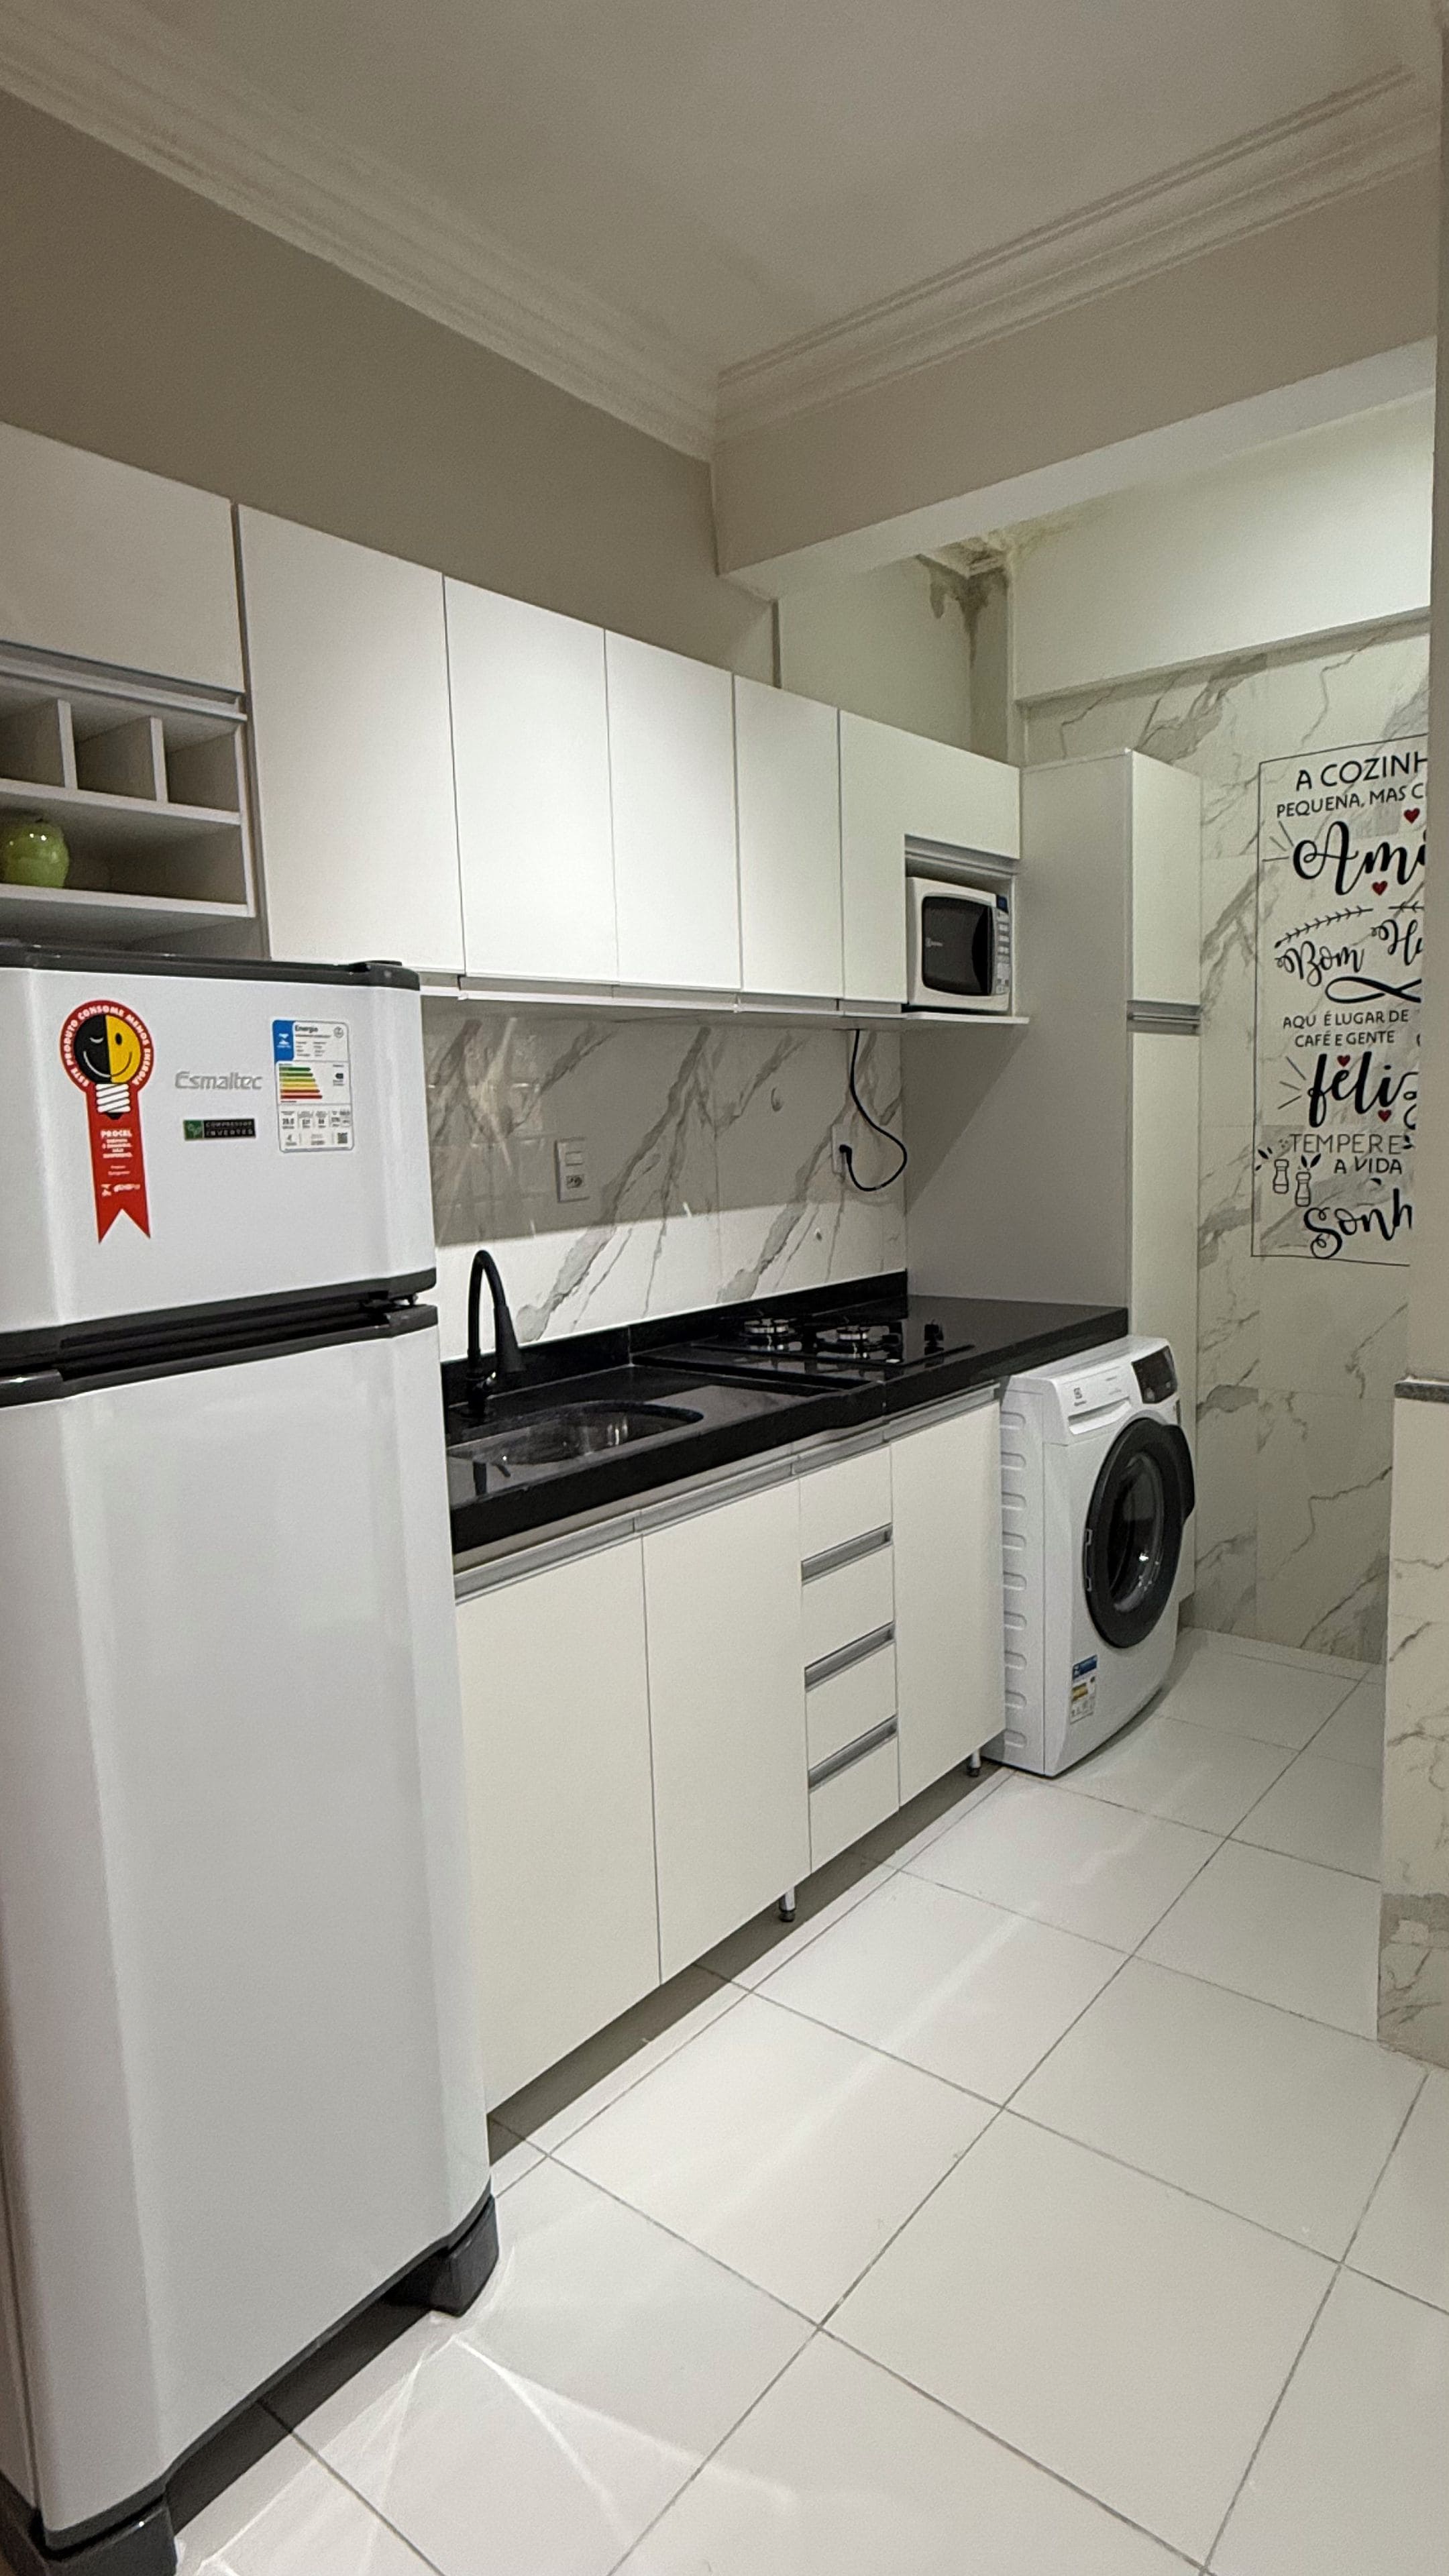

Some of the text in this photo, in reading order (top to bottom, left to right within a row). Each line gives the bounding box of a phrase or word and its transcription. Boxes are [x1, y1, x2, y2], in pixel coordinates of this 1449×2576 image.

[1296, 770, 1312, 792] A
[1277, 793, 1364, 818] PEQUENA,
[1370, 785, 1407, 804] MAS
[1275, 941, 1364, 987] Bom
[1324, 1011, 1332, 1026] É
[1336, 1011, 1385, 1026] LUGAR
[1389, 1009, 1409, 1022] DE
[64, 1005, 151, 1087] ESTE PRODUTO CONSOME MENOS ENERGIA
[1295, 1030, 1395, 1047] CAFÉ E GENTE
[175, 1071, 262, 1089] Esmaltec
[1289, 1134, 1402, 1155] TEMPERE
[1334, 1156, 1402, 1174] A VIDA
